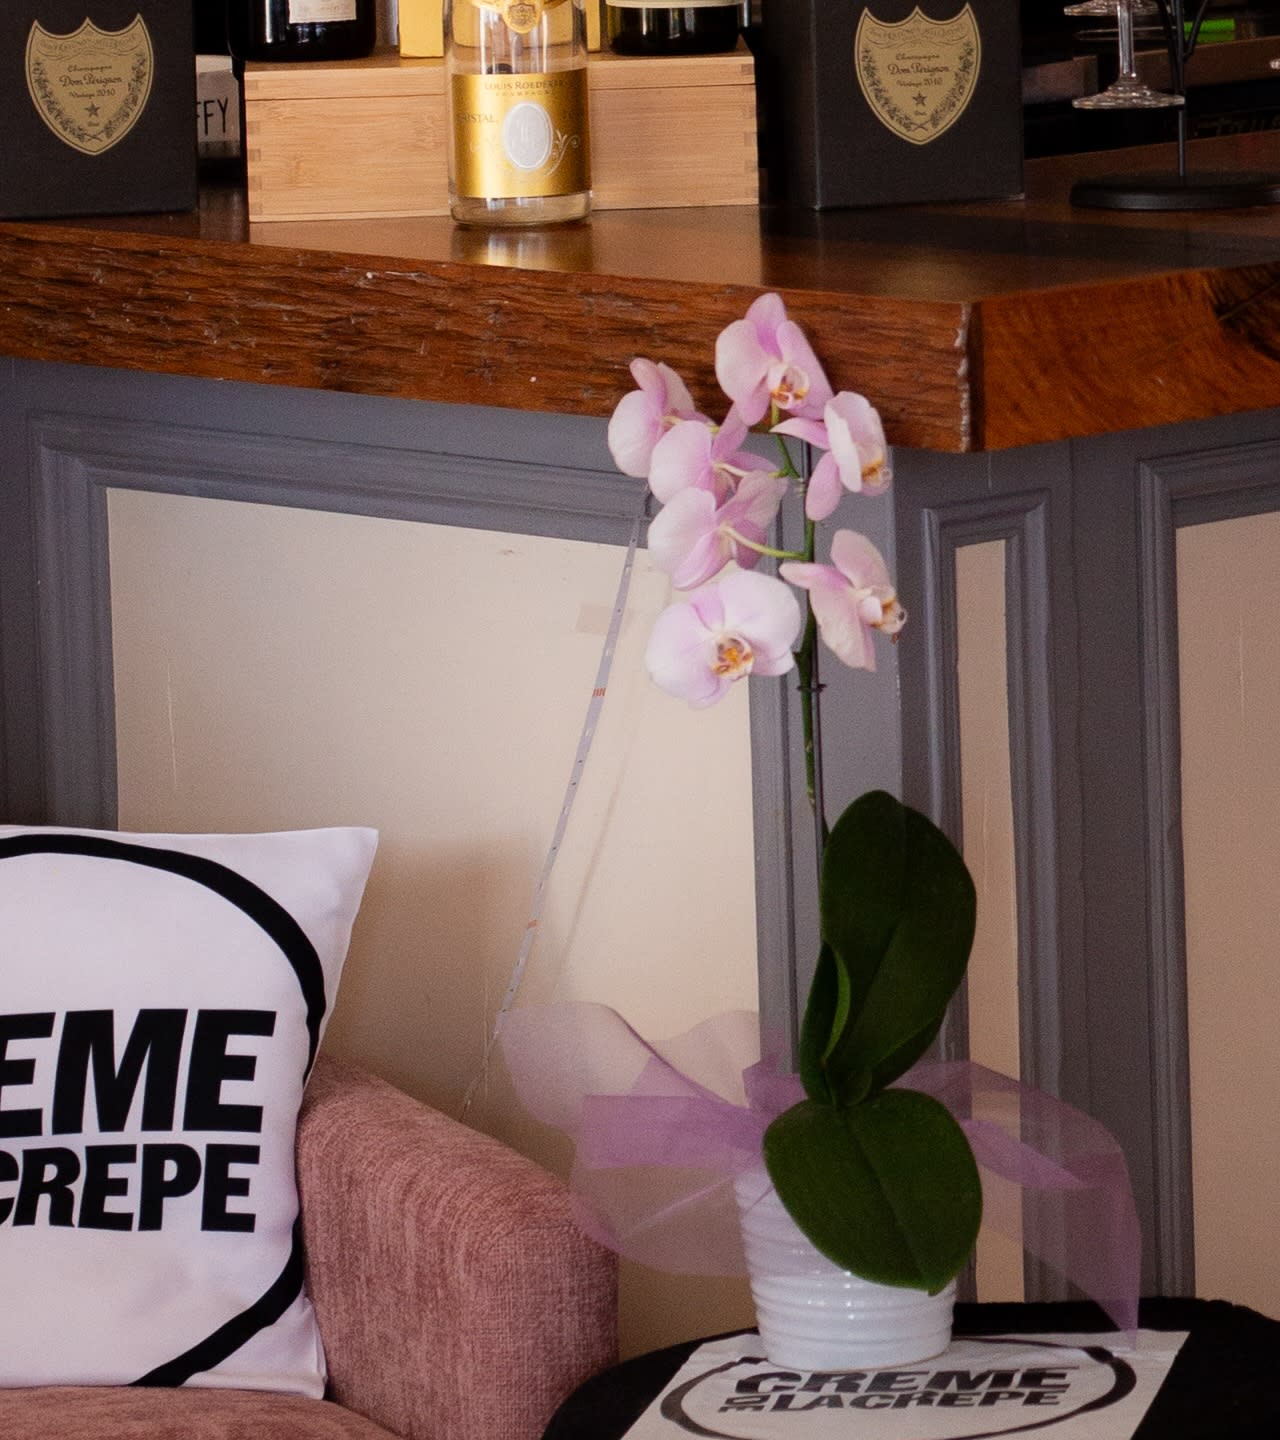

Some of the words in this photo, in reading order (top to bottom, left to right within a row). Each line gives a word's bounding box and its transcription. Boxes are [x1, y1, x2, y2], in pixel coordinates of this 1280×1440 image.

[895, 52, 940, 62] Champagne
[67, 64, 113, 73] Champagne
[887, 63, 911, 75] Dom
[59, 75, 84, 88] Dom
[484, 80, 513, 90] LOUIS
[95, 88, 116, 97] 2010
[733, 1366, 1080, 1394] CREME
